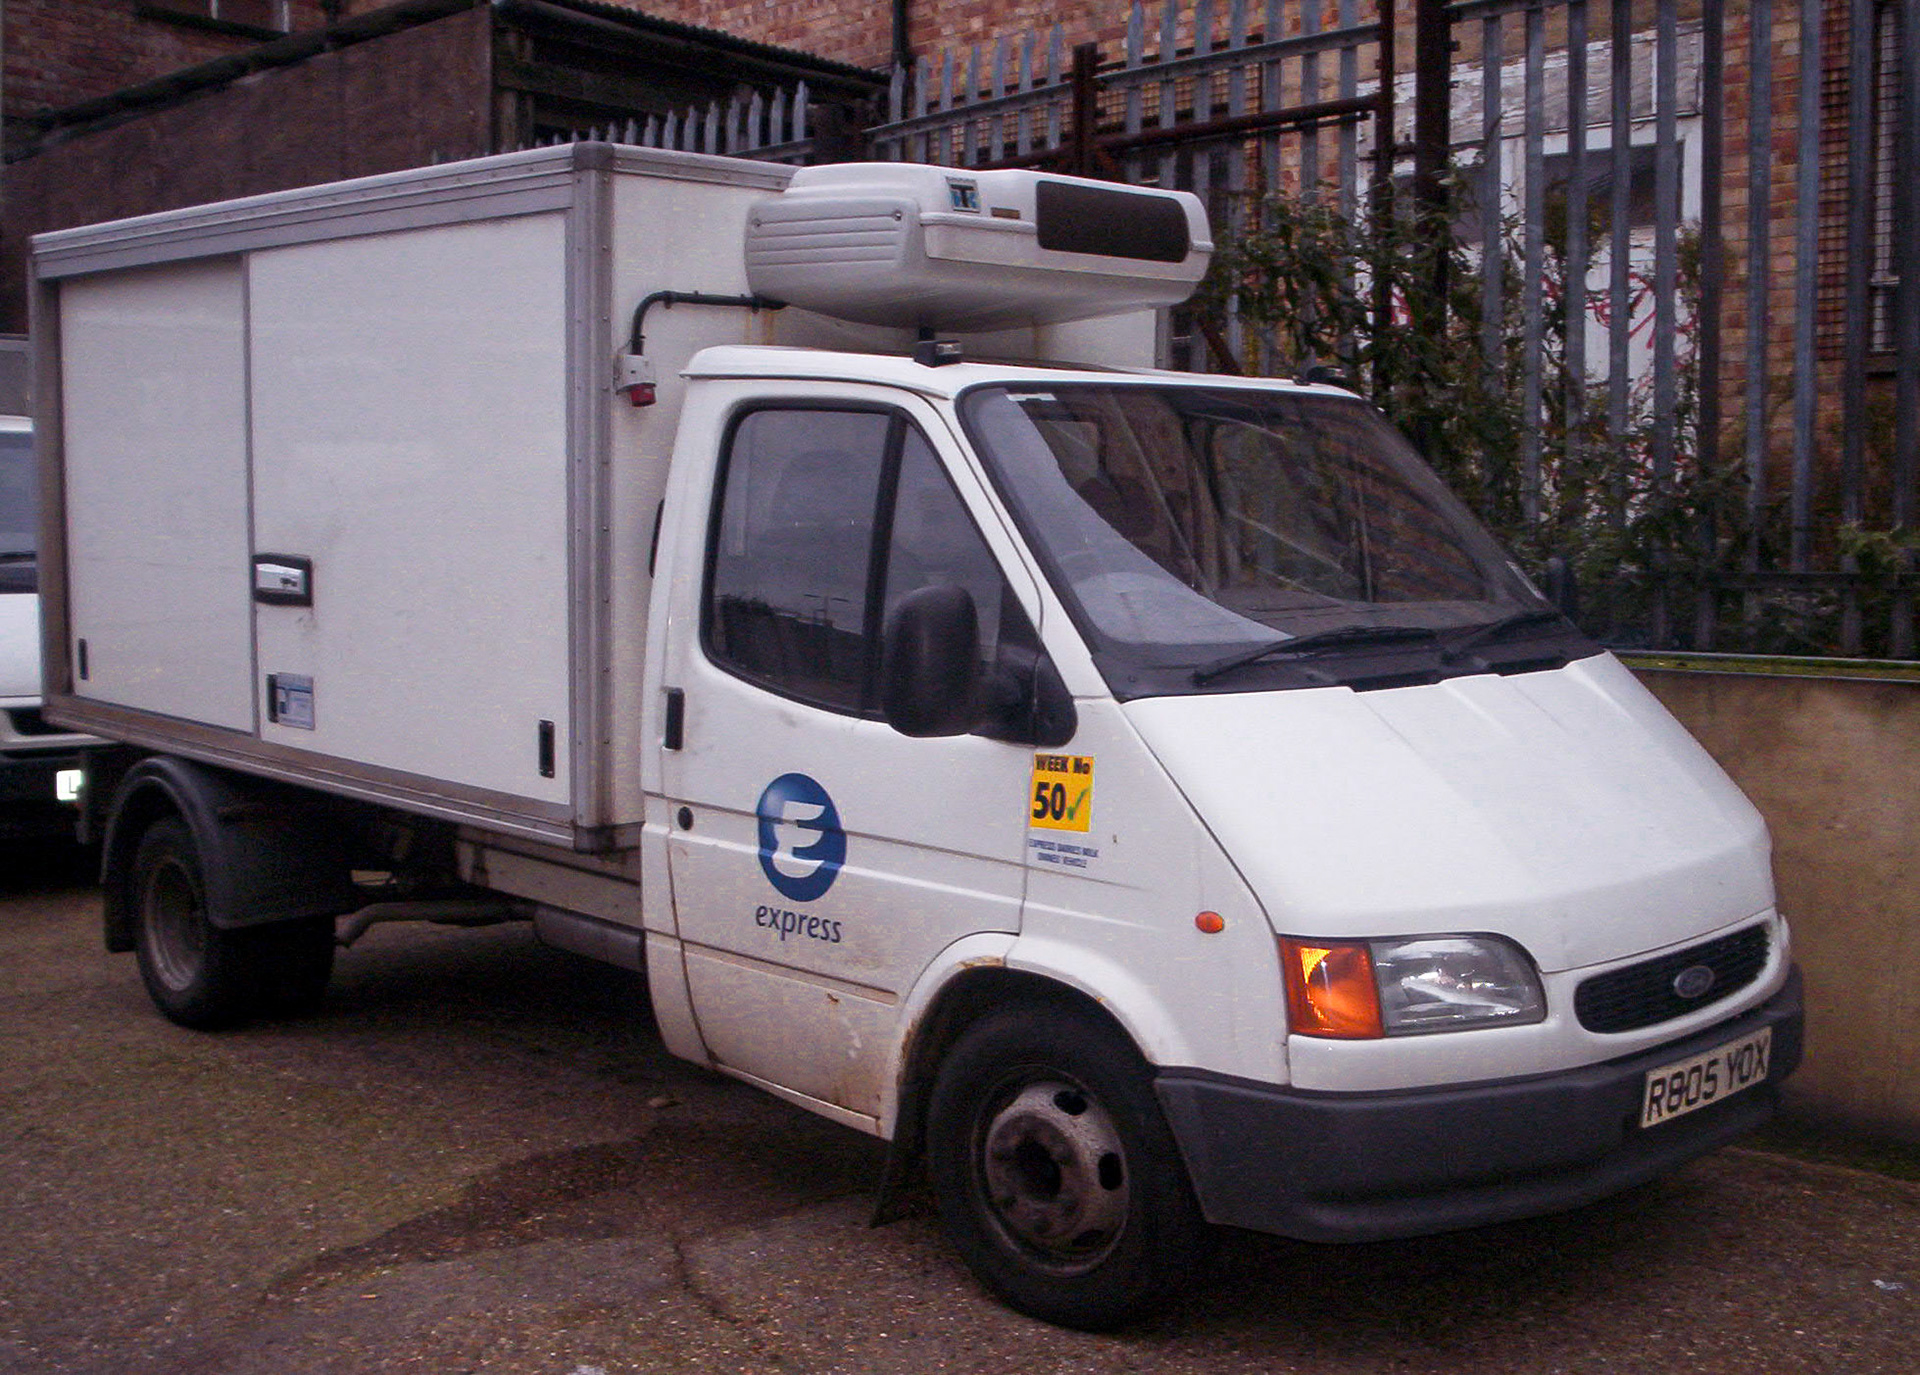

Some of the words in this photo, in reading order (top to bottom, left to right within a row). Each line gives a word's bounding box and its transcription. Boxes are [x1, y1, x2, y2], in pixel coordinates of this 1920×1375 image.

[1036, 755, 1068, 773] WEEK
[1073, 757, 1091, 774] No
[1033, 781, 1066, 821] 50
[755, 904, 843, 944] express
[1646, 1057, 1720, 1121] R805
[1726, 1036, 1770, 1091] YOX
